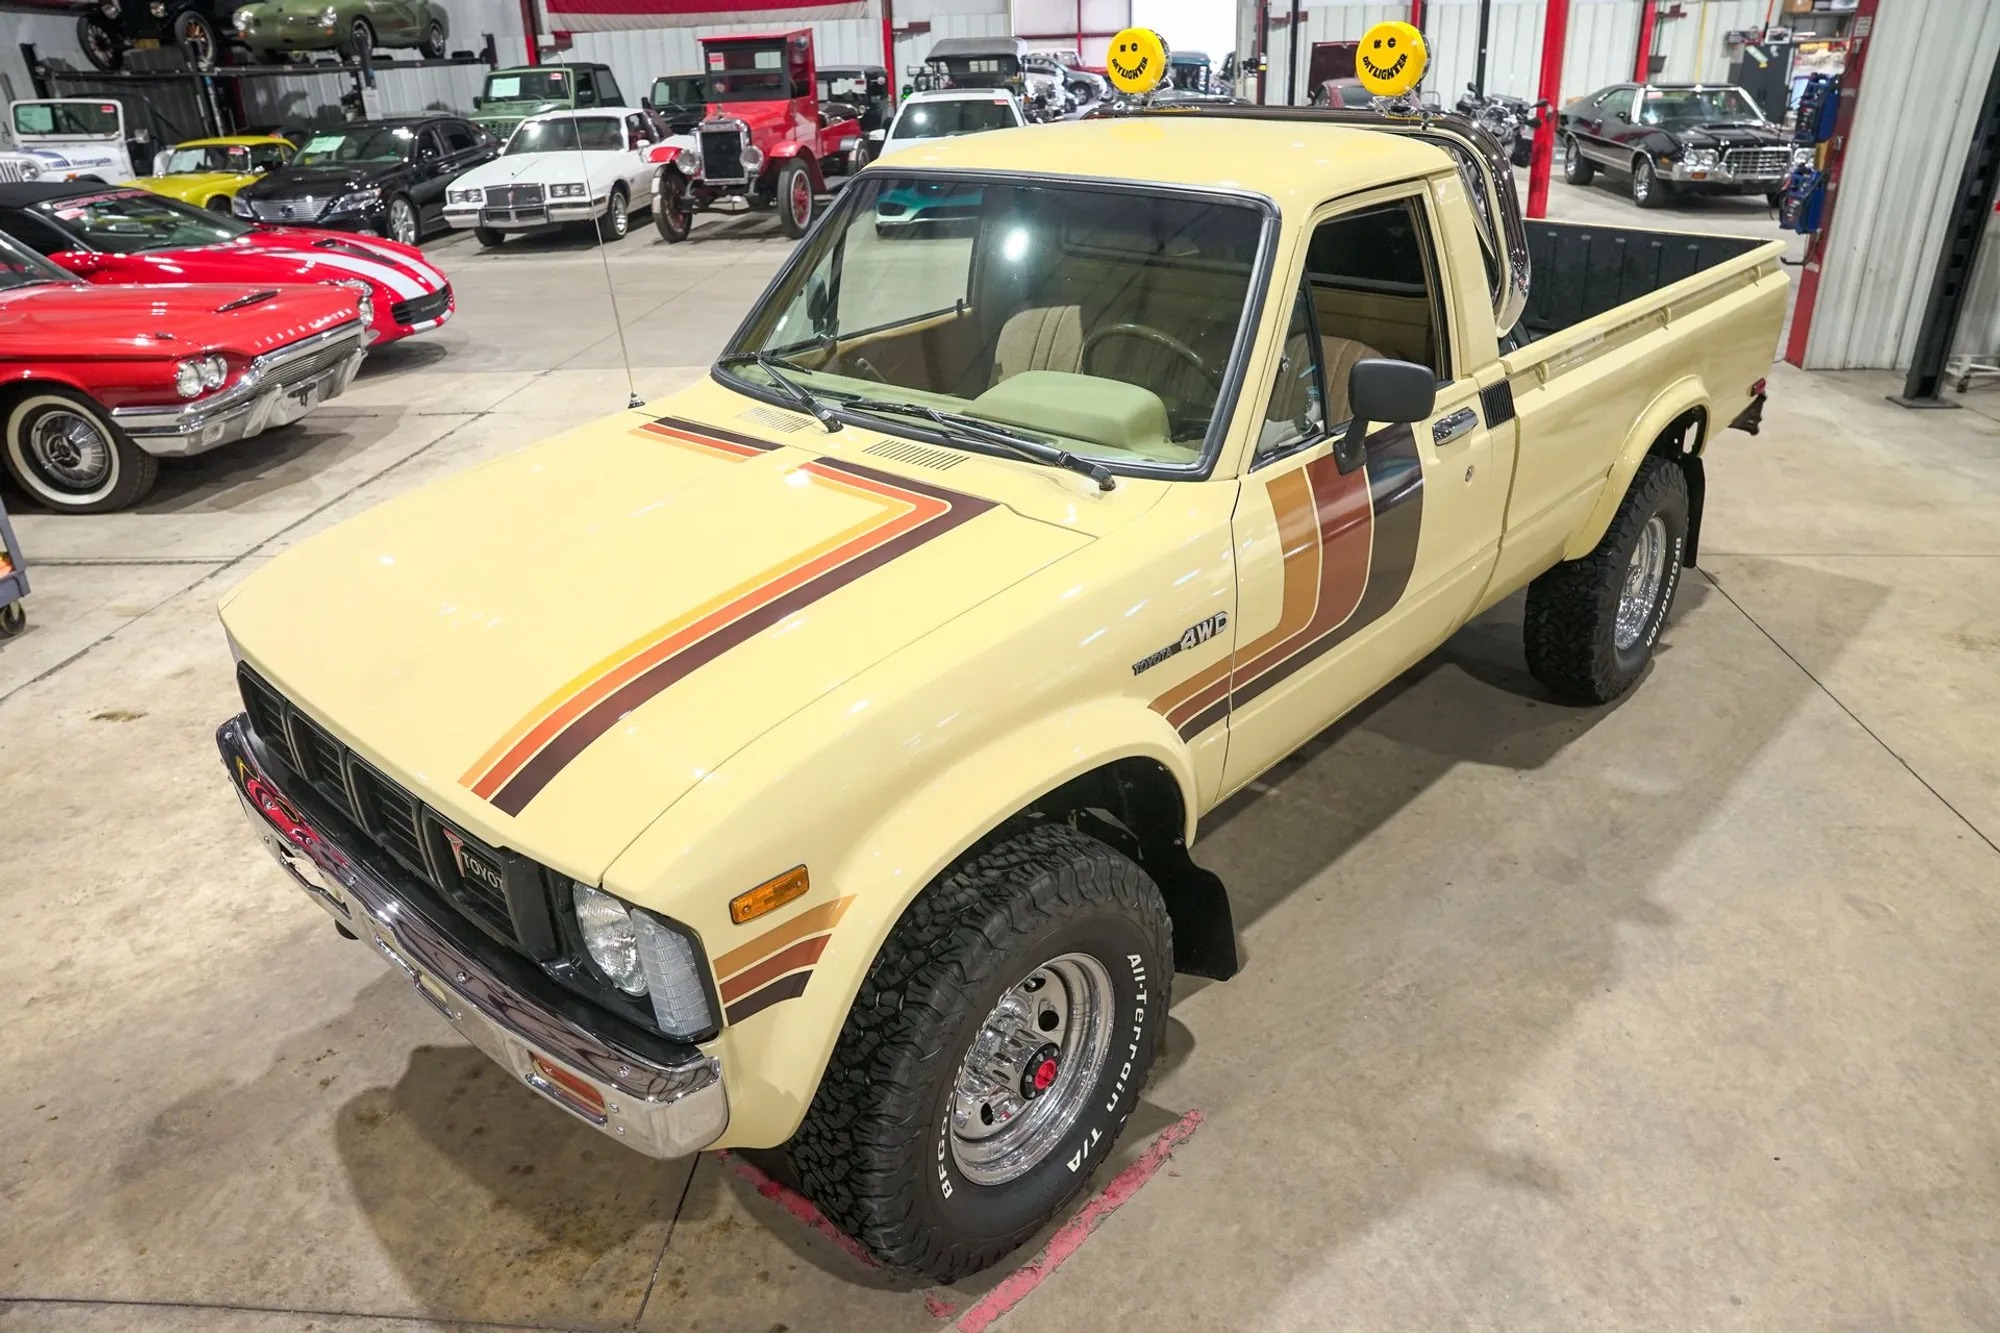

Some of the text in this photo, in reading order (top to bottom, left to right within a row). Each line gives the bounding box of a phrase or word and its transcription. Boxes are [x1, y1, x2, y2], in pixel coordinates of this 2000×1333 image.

[1111, 56, 1148, 79] DAYLIGHTER
[1362, 53, 1408, 80] DAYLIGHTER
[1132, 611, 1228, 676] TOYOTA 4WD
[461, 852, 504, 893] TOYOT
[1106, 954, 1147, 1112] All-Terrain
[1067, 1128, 1102, 1173] T/A
